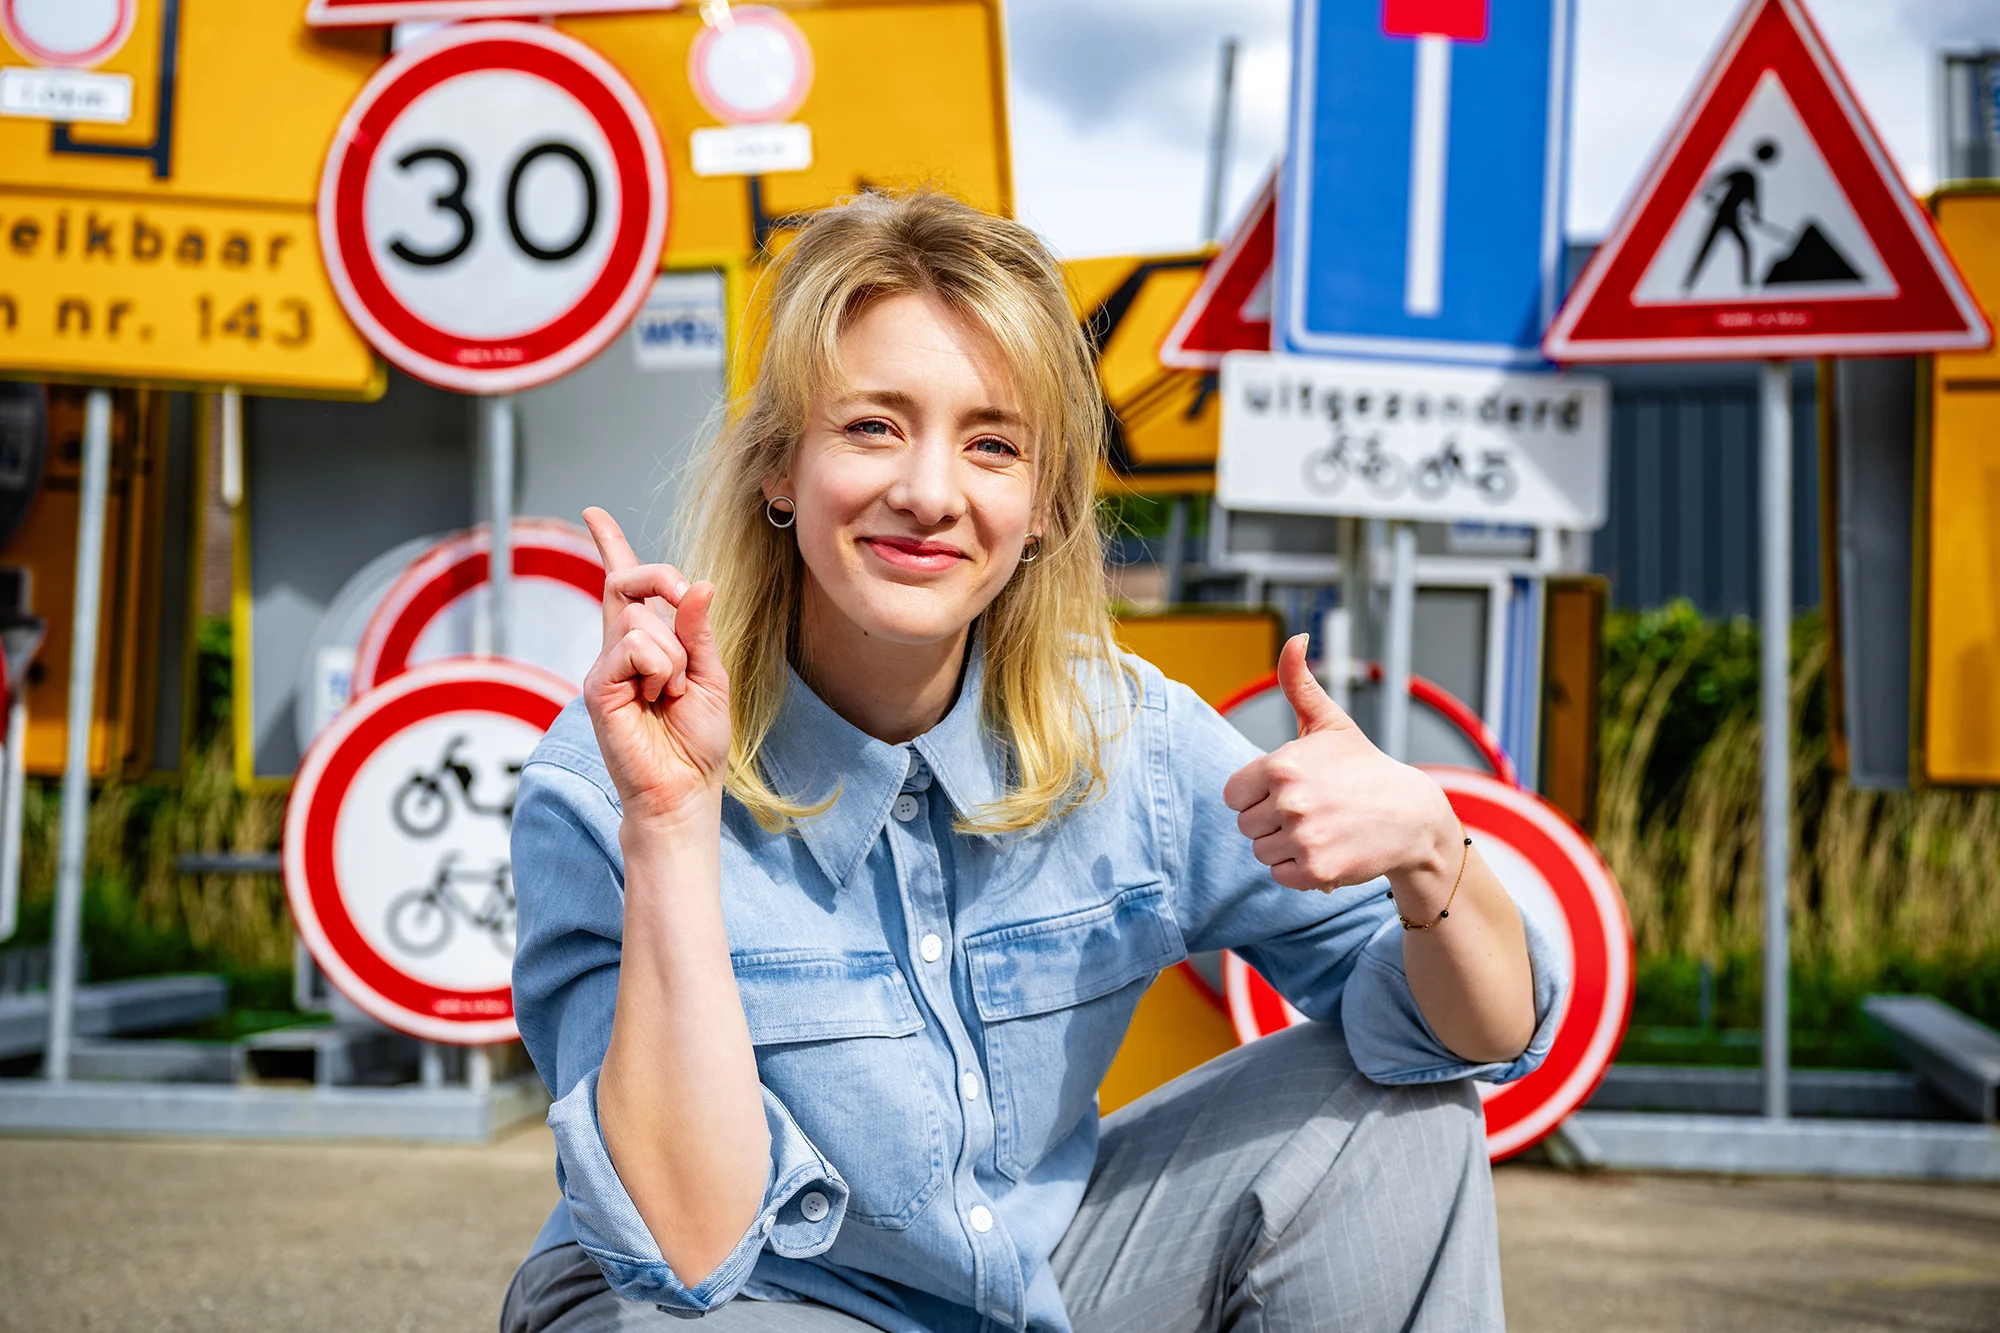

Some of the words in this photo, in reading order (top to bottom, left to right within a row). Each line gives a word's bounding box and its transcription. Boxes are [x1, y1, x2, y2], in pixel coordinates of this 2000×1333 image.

[388, 141, 599, 267] 30
[0, 208, 293, 269] eikbaar
[57, 297, 154, 340] nr.
[197, 294, 312, 347] 143
[1245, 380, 1581, 434] uitgezonderd
